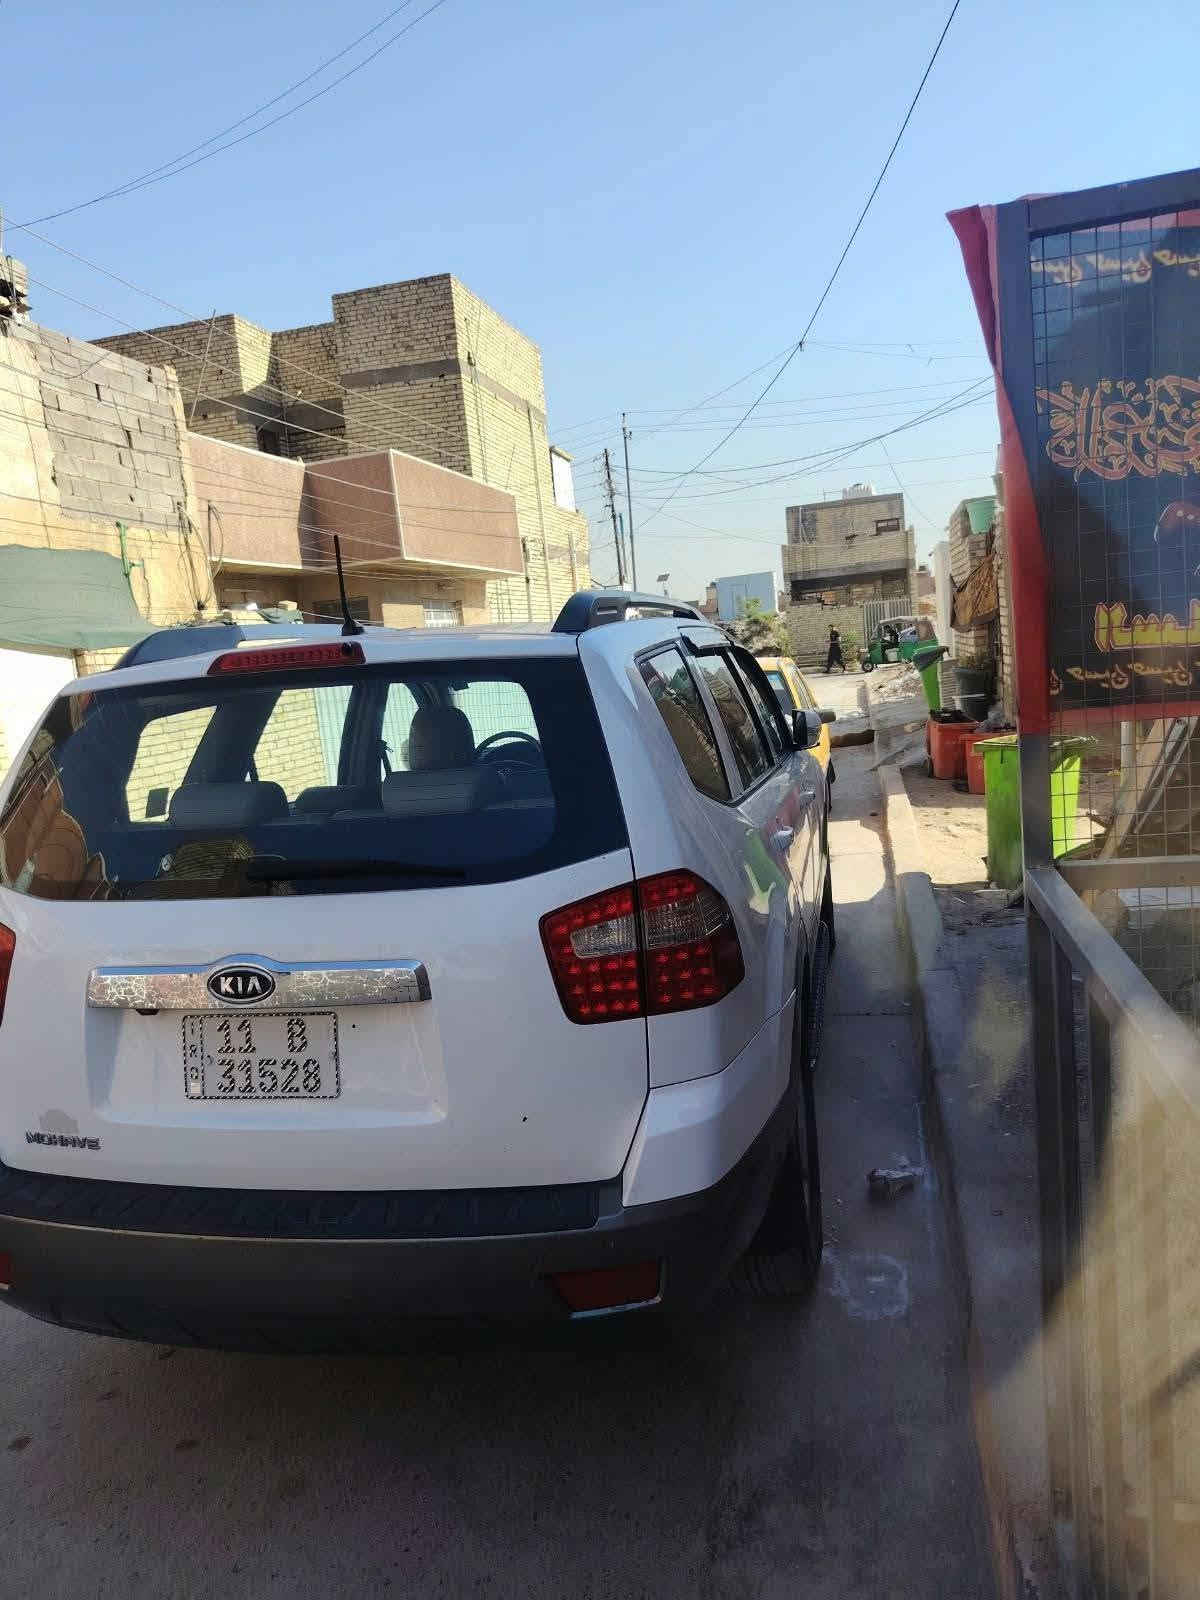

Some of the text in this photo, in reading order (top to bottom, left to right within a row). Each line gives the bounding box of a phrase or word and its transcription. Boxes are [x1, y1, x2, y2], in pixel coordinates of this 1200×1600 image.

[220, 975, 263, 995] KIA
[216, 1017, 308, 1054] 11 B
[216, 1057, 321, 1094] 31528
